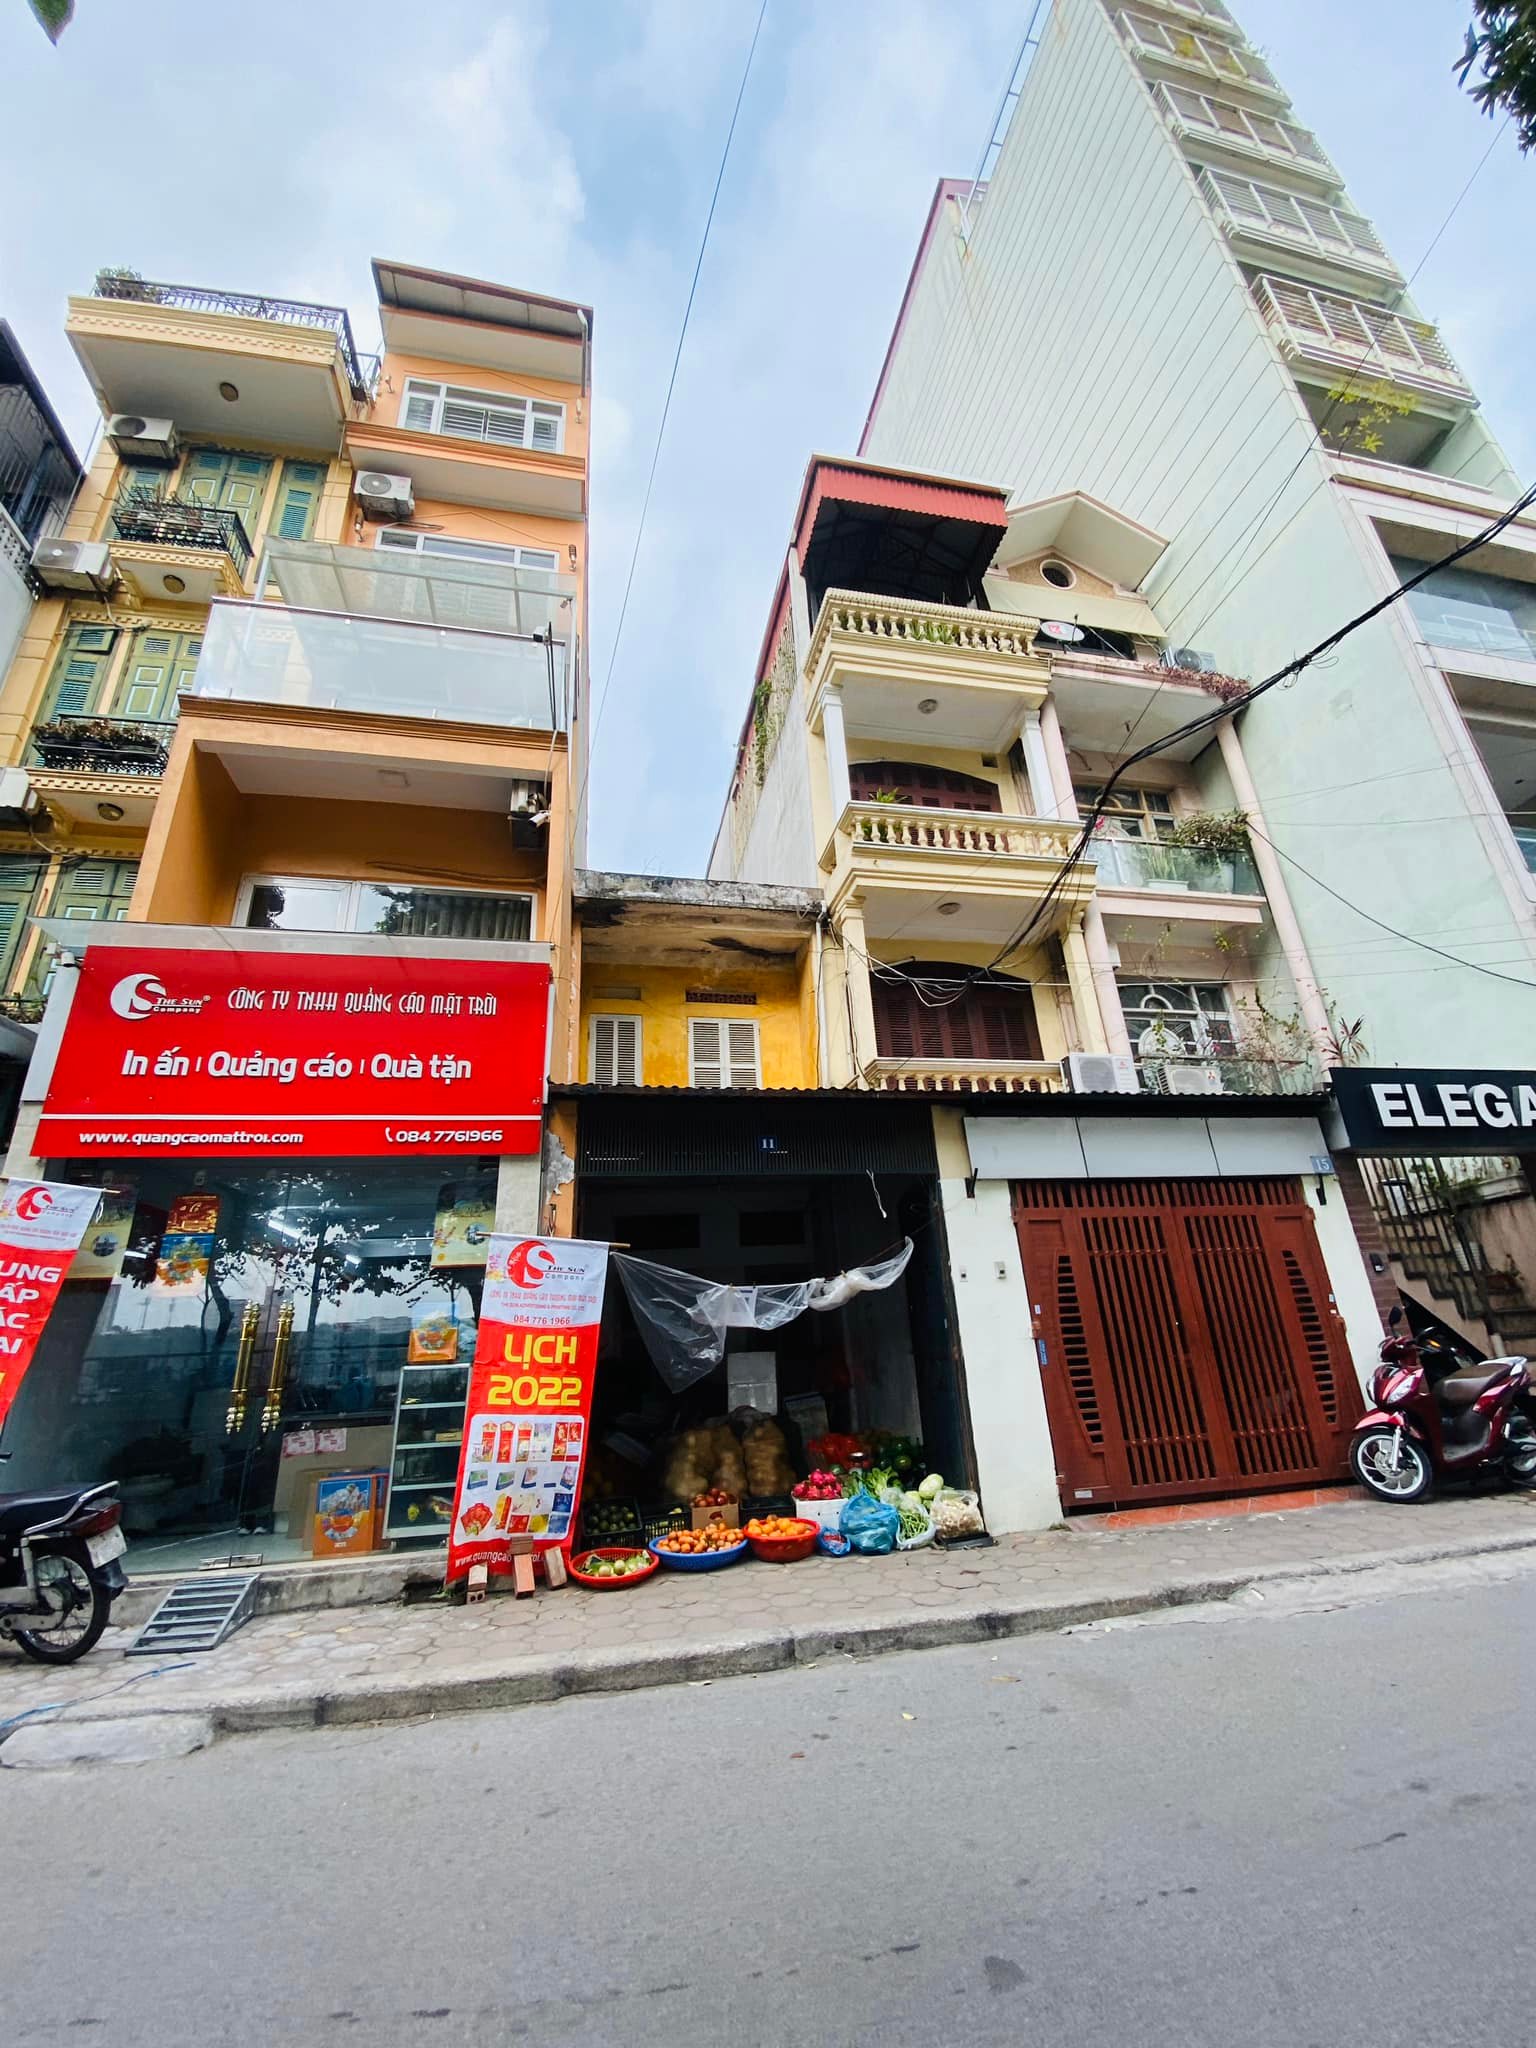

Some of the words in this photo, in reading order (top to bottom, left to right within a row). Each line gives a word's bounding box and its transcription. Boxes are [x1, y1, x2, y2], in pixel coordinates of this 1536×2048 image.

[228, 987, 265, 1010] CÔNG
[271, 990, 290, 1010] TY
[297, 991, 338, 1012] TNHH
[344, 987, 392, 1014] QUẢNG
[399, 991, 426, 1014] CÁO
[431, 994, 463, 1018] MẶT
[468, 994, 497, 1016] TRỜI
[121, 1050, 149, 1076] In
[153, 1046, 190, 1077] ấn
[207, 1050, 298, 1083] Quảng
[303, 1052, 353, 1078] cáo
[370, 1053, 424, 1079] Quà
[429, 1054, 472, 1085] tặn
[761, 1138, 775, 1149] 11
[1315, 1159, 1330, 1171] 15
[504, 1333, 578, 1370] LỊCH
[487, 1375, 582, 1406] 2022
